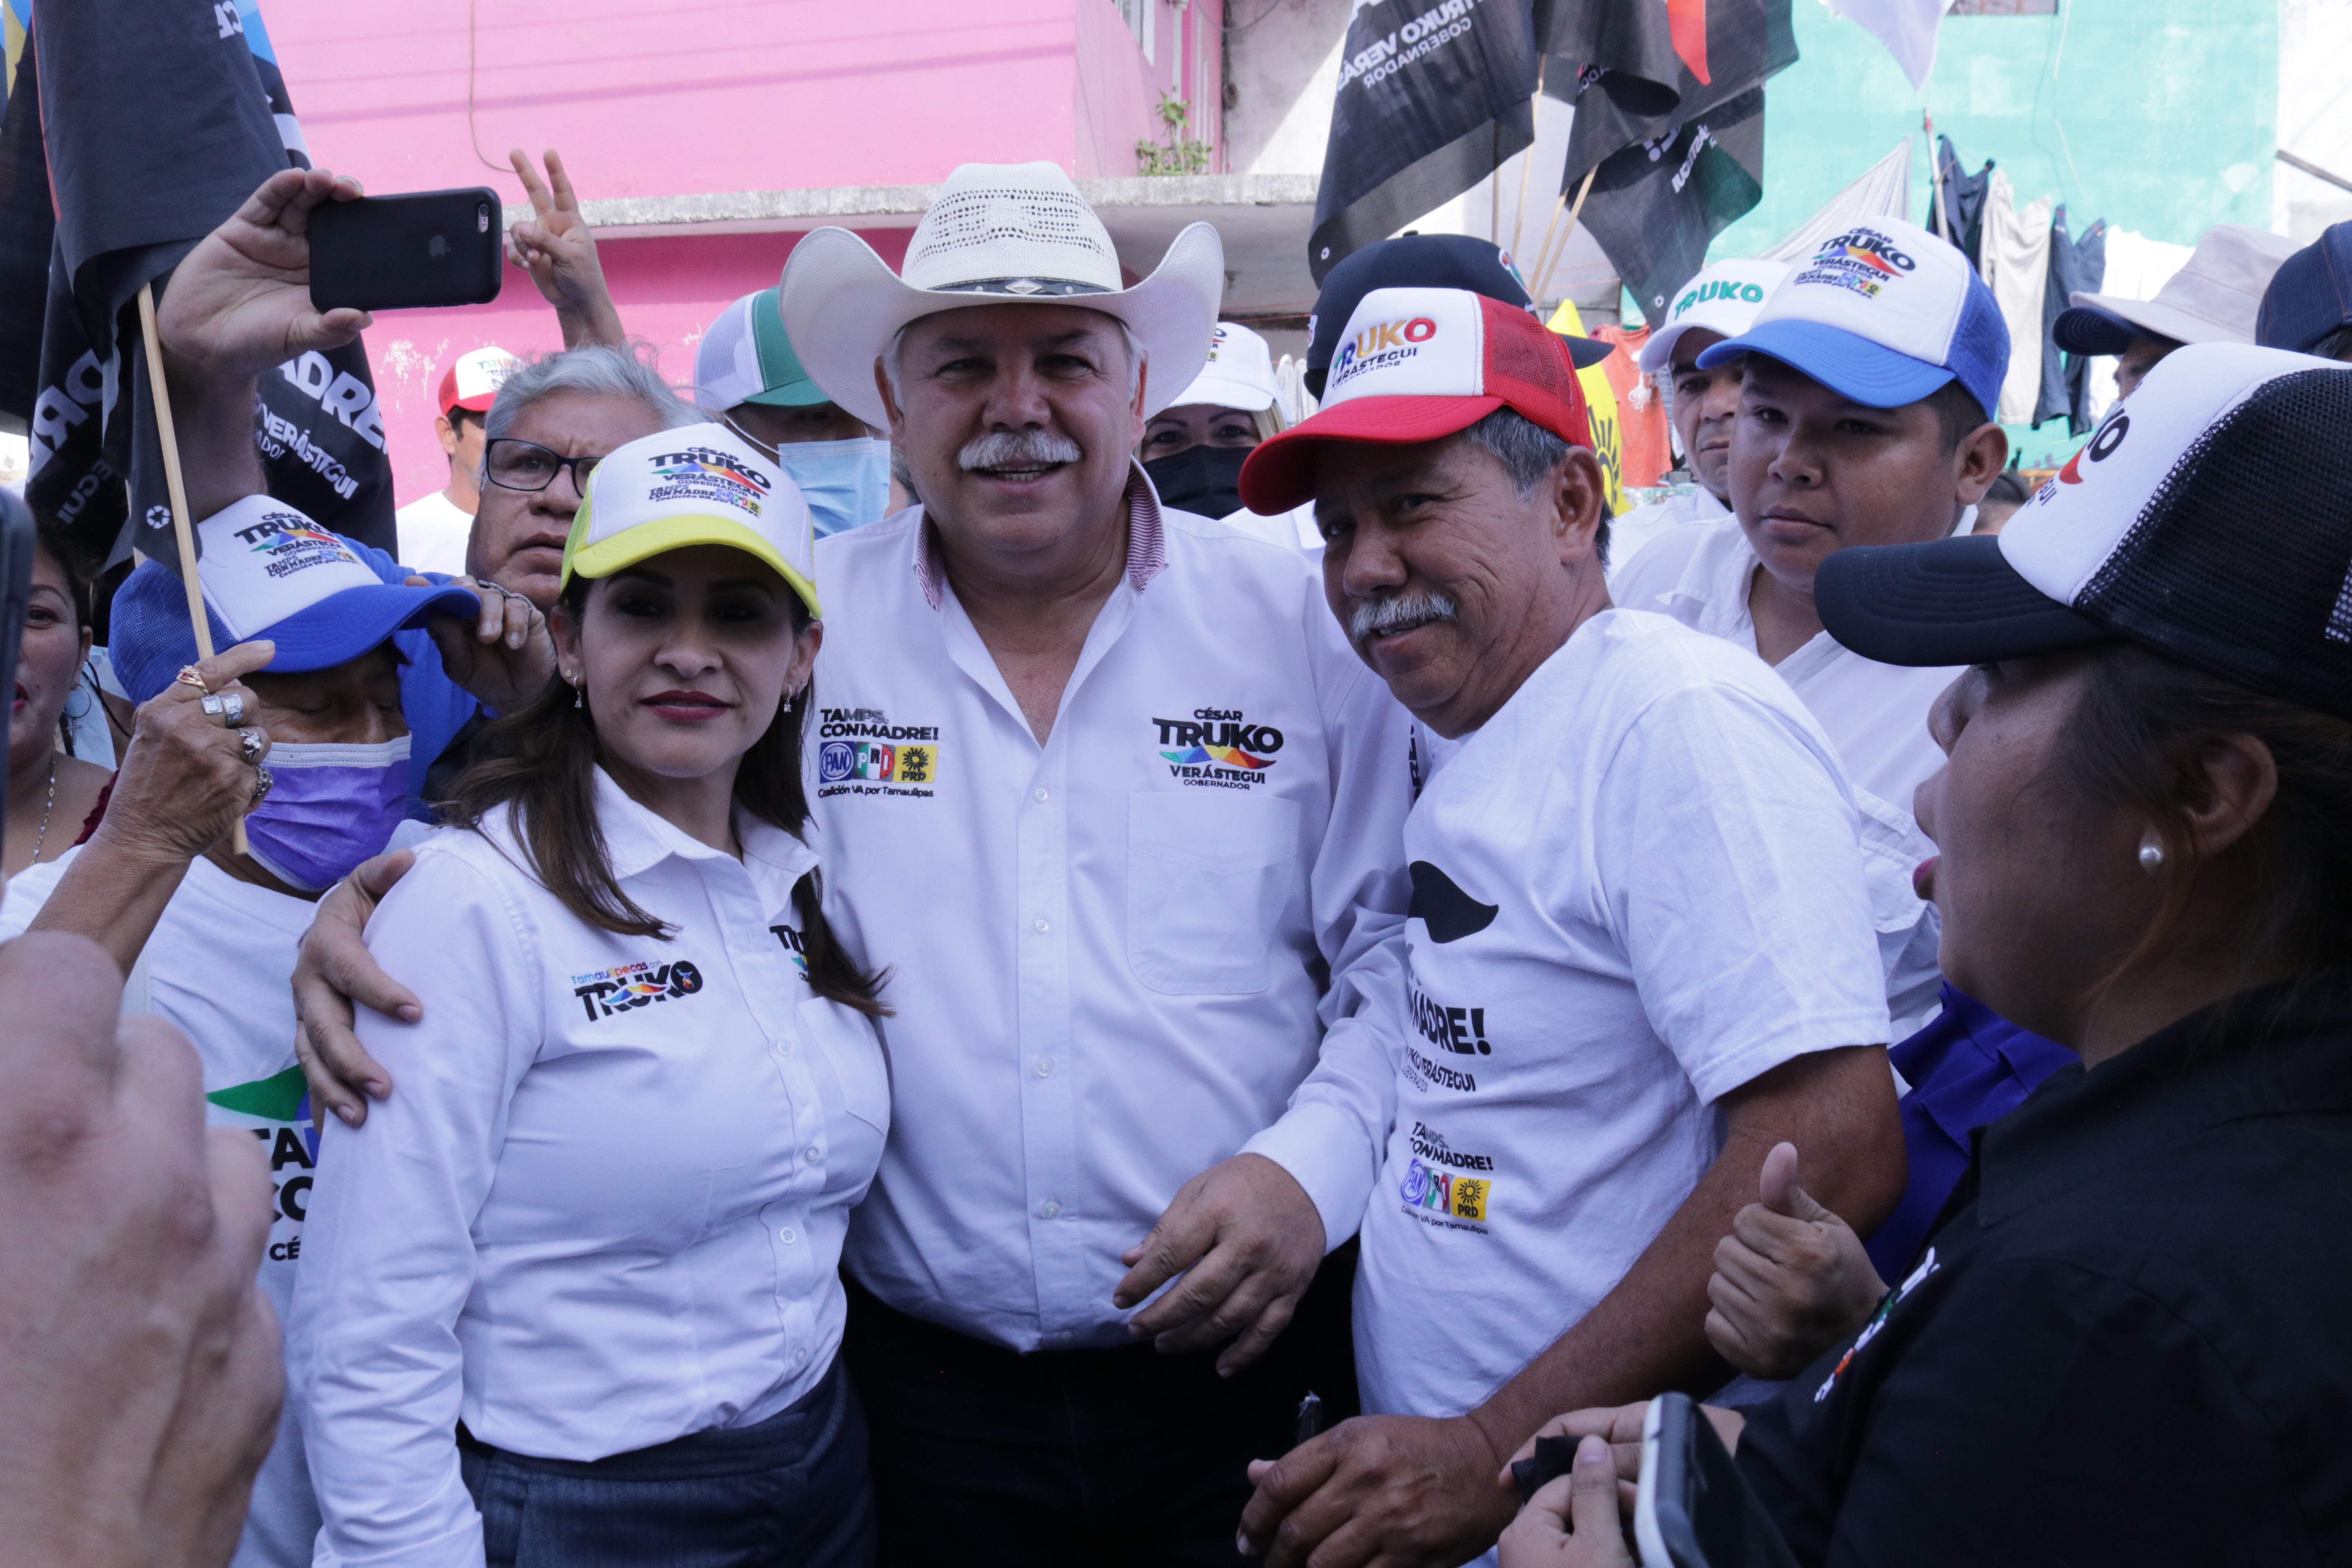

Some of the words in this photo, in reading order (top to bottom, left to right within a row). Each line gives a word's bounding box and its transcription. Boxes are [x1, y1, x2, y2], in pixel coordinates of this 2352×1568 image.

[1849, 227, 1893, 244] CÉSAR
[1818, 235, 1916, 271] TRUKO
[1813, 256, 1891, 282] VERÁSTEGUI
[1675, 280, 1763, 321] TRUKO
[687, 447, 739, 462] CÉSAR
[648, 452, 771, 489] TRUKO
[662, 472, 760, 500] VERÁSTEGUI
[677, 480, 748, 497] GOBERNADOR
[233, 519, 335, 544] TRUKO
[820, 708, 889, 724] TAMPS.
[1194, 707, 1243, 722] CÉSAR
[1152, 717, 1284, 754] TRUKO
[825, 752, 848, 771] PAN
[857, 748, 889, 770] PRI
[902, 771, 926, 781] PRD
[1170, 764, 1265, 784] VERÁSTEGUI
[818, 785, 850, 798] Coalición
[852, 785, 864, 793] VA
[864, 787, 881, 796] por
[882, 786, 934, 798] Tamaulipas
[1183, 779, 1250, 790] GOBERNADOR
[571, 962, 648, 985] Tamaulipecas
[649, 960, 662, 968] con
[574, 960, 703, 1022] TRUKO
[1404, 1170, 1425, 1193] PAN
[1420, 1214, 1430, 1224] VA
[1457, 1203, 1479, 1218] PRD
